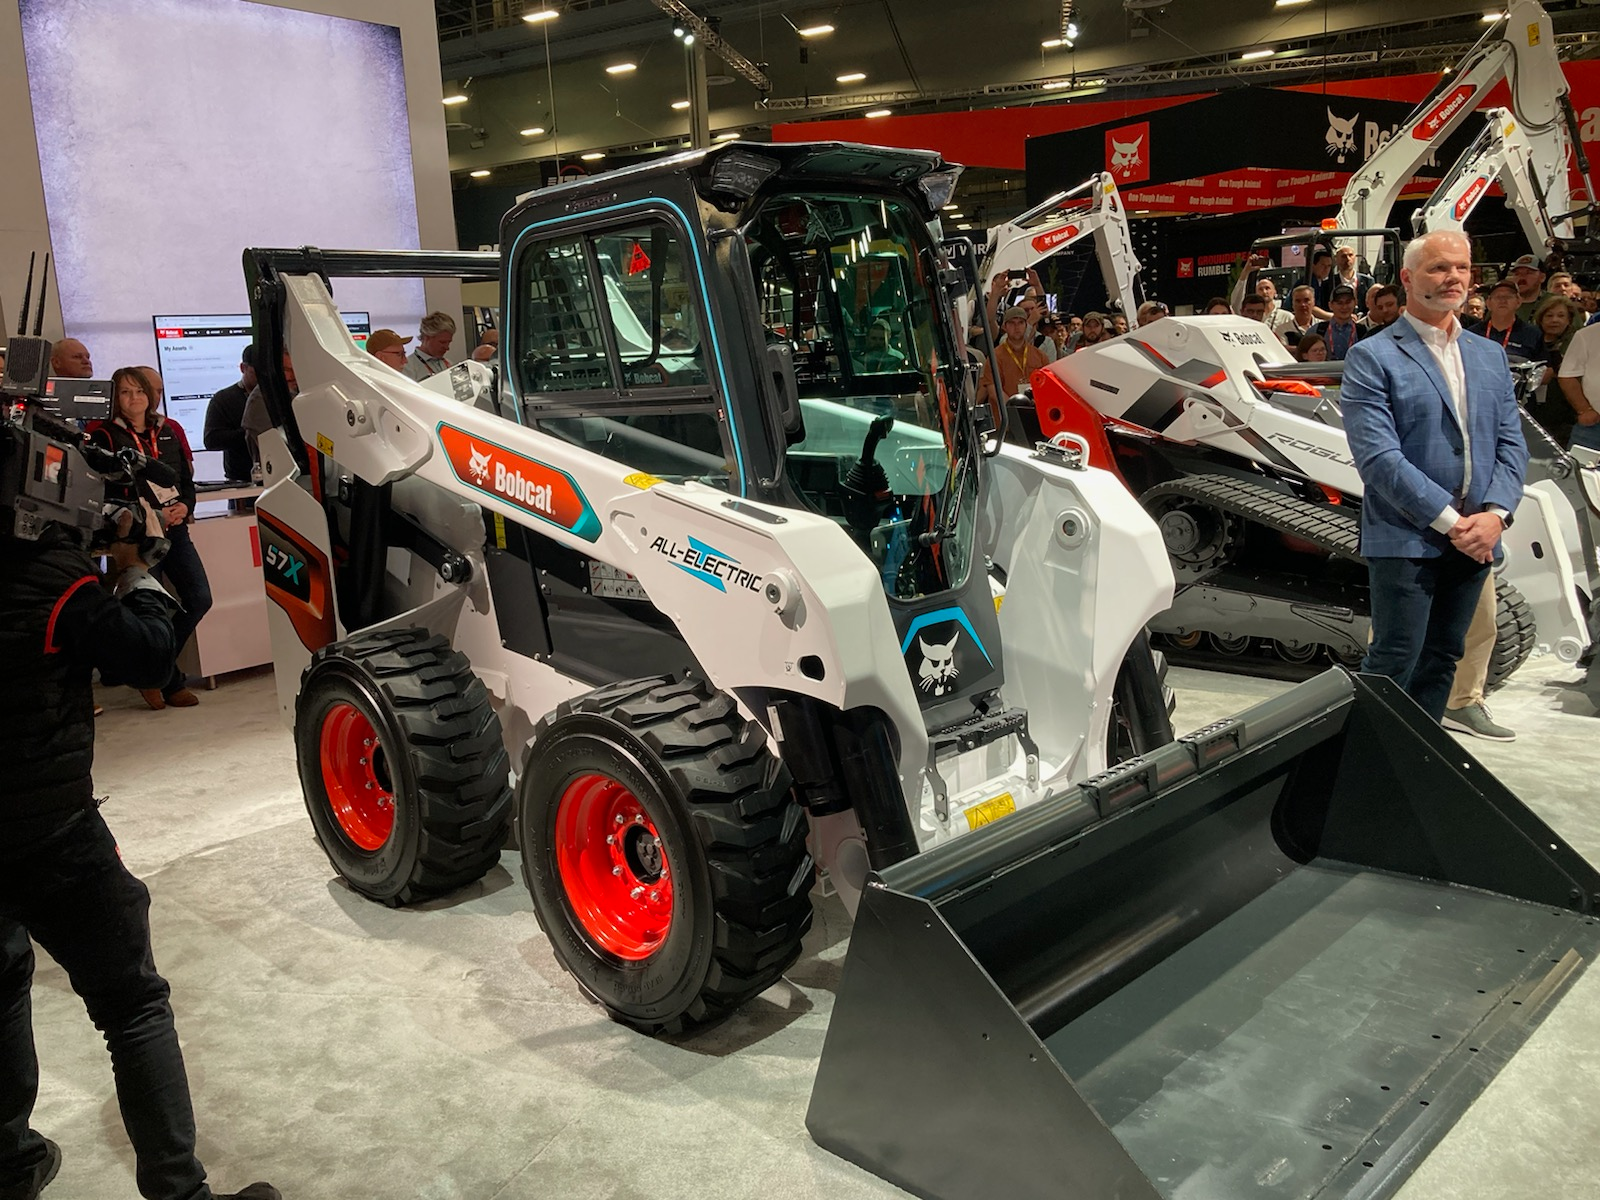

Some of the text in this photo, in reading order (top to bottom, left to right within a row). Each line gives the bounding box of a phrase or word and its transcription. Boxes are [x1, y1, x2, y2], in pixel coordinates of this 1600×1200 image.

[1438, 93, 1466, 120] Bobcat
[1218, 178, 1262, 189] One Tough Animal
[1290, 174, 1310, 186] Tough
[1310, 171, 1335, 183] Animal
[1127, 192, 1175, 204] One Tough Animal
[1189, 196, 1234, 206] One Tough Animal
[1246, 196, 1257, 206] One
[1256, 197, 1272, 207] Tough
[1314, 190, 1329, 199] One
[1052, 230, 1070, 243] Bobcat
[1197, 263, 1232, 277] RUMBLE
[1233, 332, 1266, 346] Bobcat
[633, 372, 663, 384] Bobcat
[1267, 432, 1356, 467] ROGU
[495, 461, 553, 514] Bobcat
[266, 544, 305, 586] S7X
[650, 536, 763, 593] ALL-ELECTRIC
